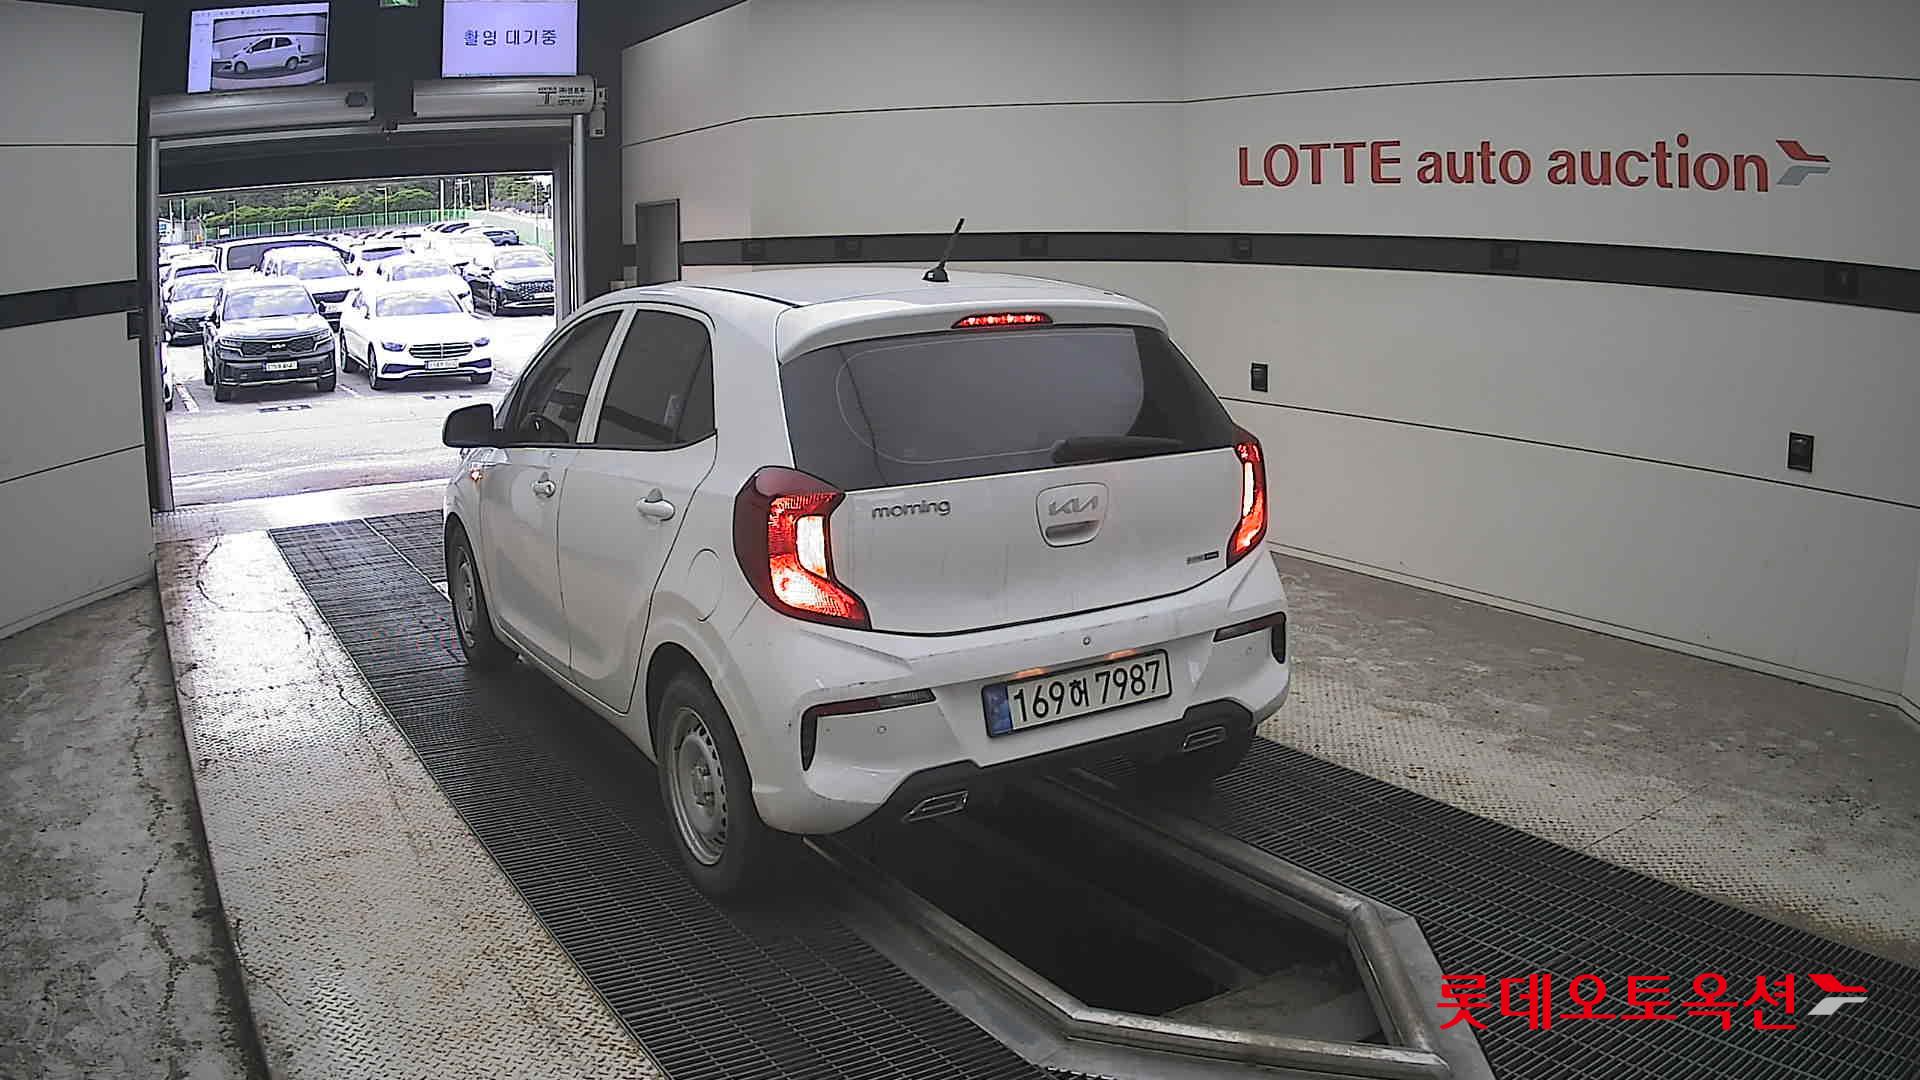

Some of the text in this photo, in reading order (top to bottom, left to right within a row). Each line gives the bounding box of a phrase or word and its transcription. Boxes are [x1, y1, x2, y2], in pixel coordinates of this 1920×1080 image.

[505, 30, 557, 46] 대기중
[1239, 133, 1769, 193] LOTTE auto auction
[872, 500, 951, 519] morning
[1095, 659, 1160, 705] 7987
